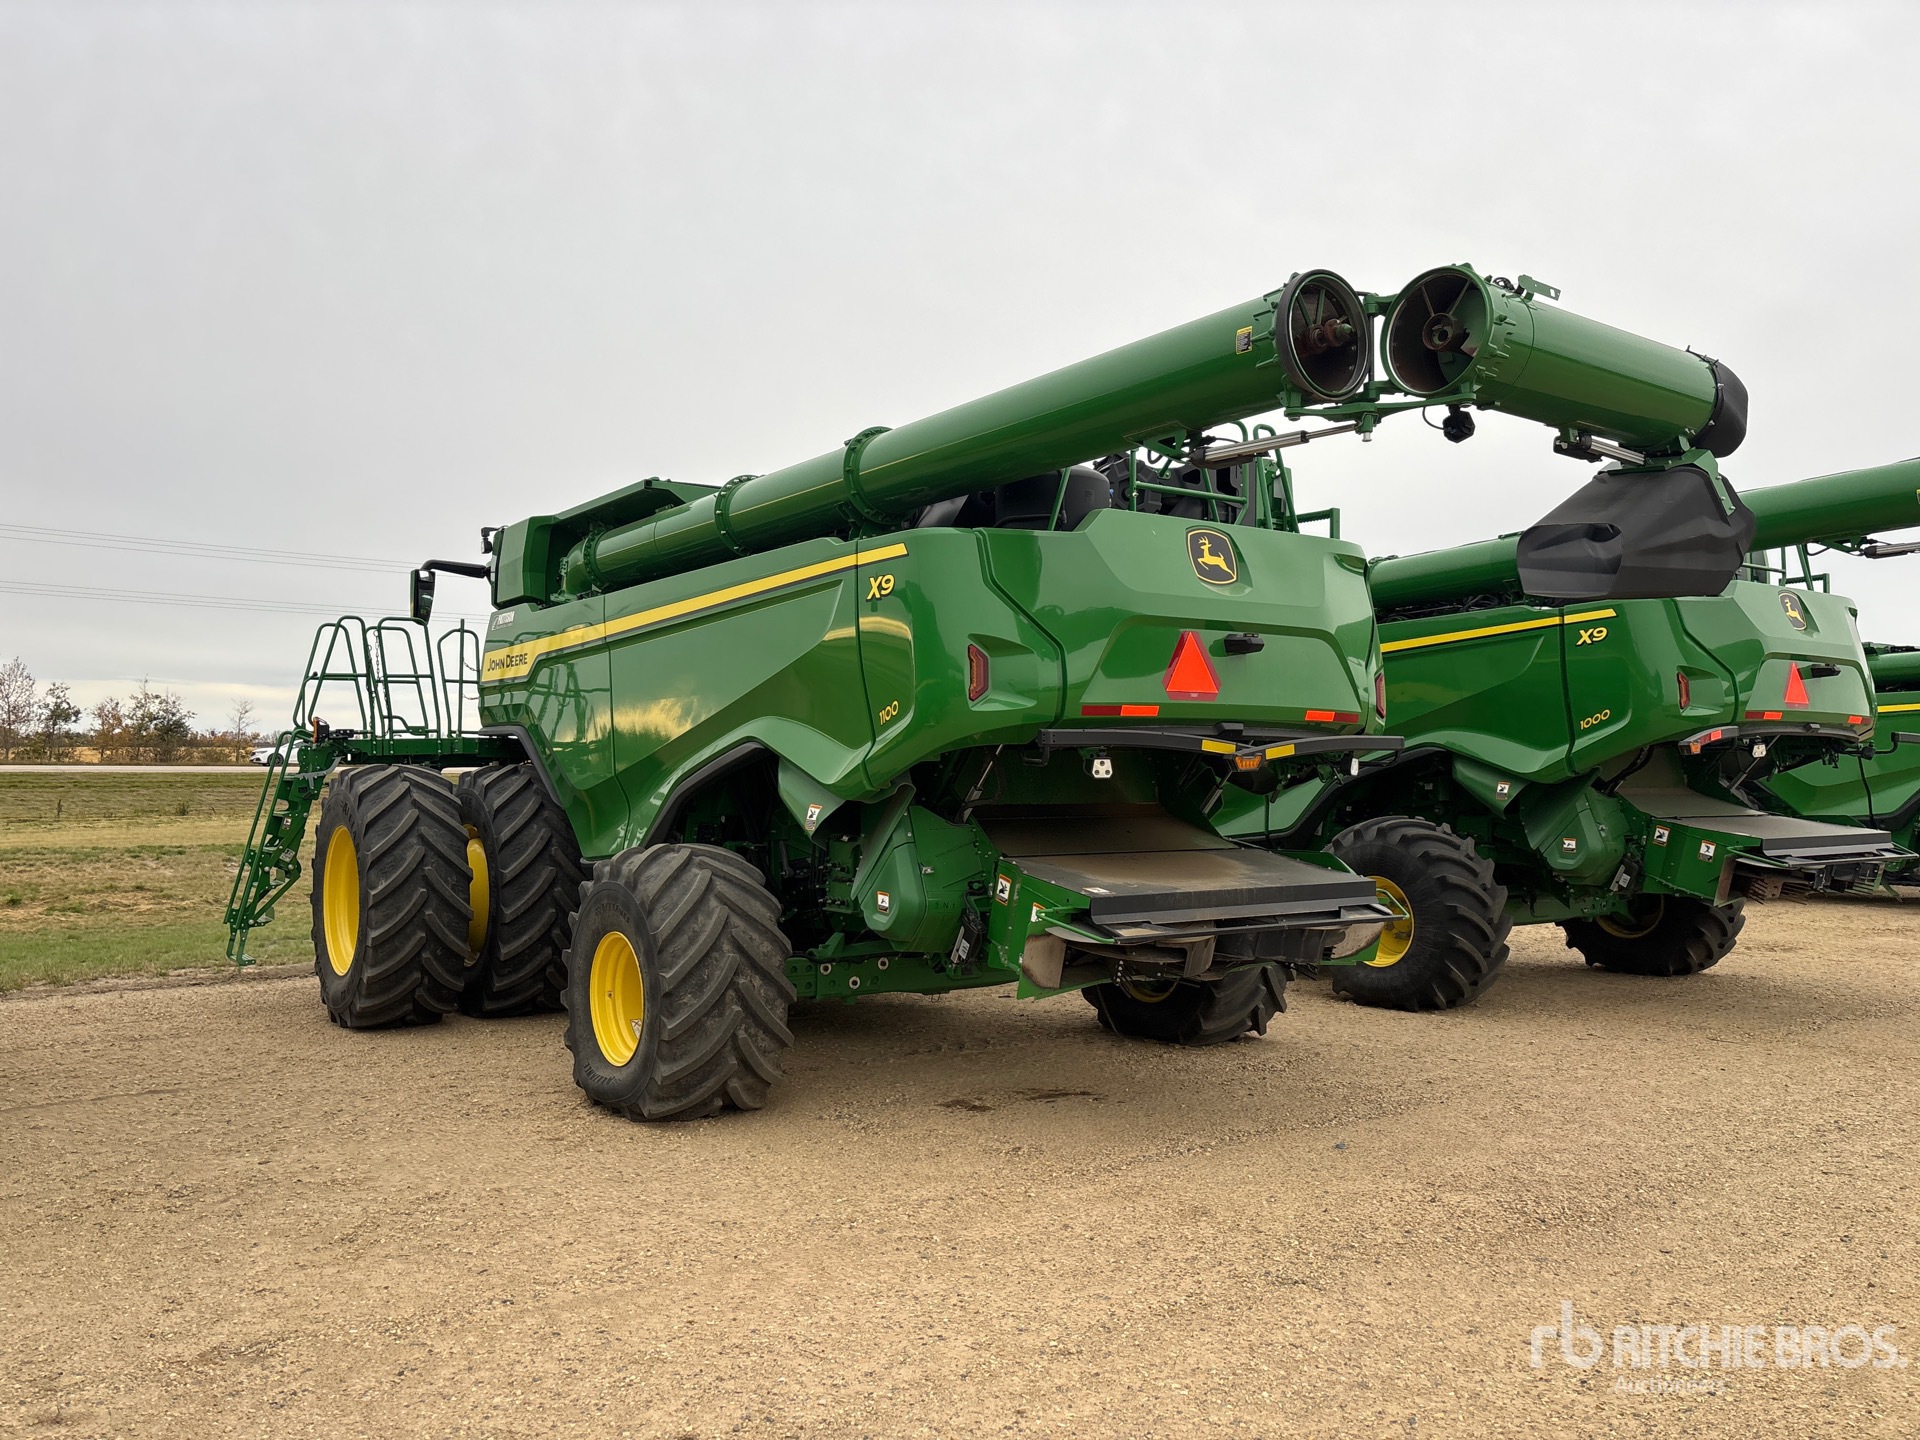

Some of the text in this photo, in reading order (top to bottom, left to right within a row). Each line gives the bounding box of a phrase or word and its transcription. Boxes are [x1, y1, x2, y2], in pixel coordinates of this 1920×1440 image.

[866, 574, 895, 602] X9
[1576, 627, 1608, 646] X9
[487, 653, 528, 672] JOHN DEERE
[879, 700, 899, 725] 1100
[1580, 709, 1611, 730] 1000
